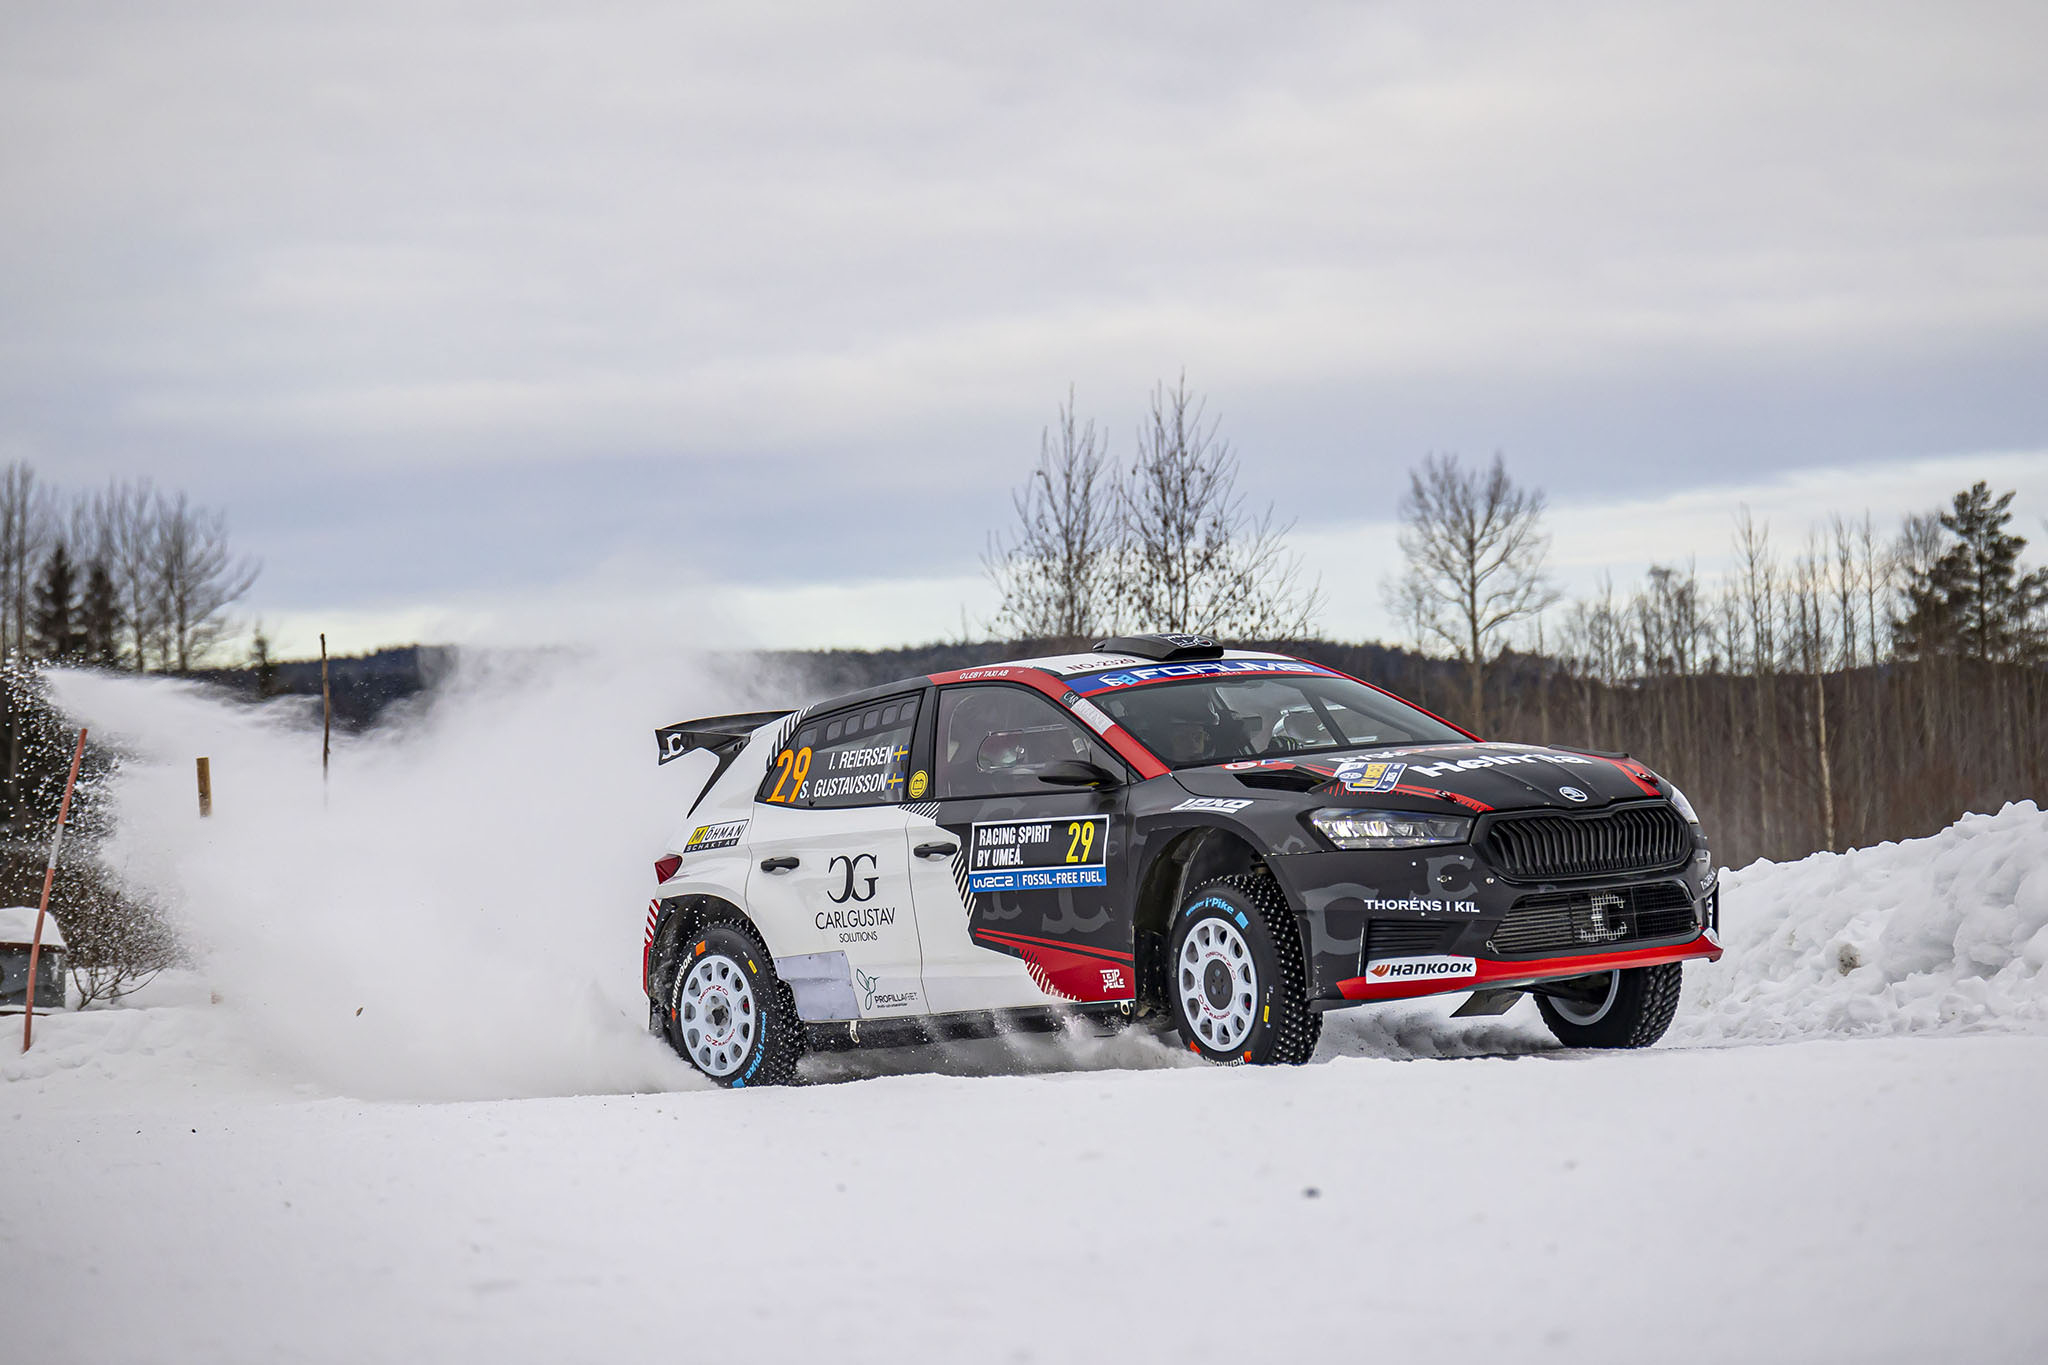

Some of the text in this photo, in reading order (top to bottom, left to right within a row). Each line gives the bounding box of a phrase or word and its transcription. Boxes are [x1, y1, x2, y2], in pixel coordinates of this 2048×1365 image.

[838, 745, 894, 769] REIERSEN
[1408, 753, 1593, 778] Helmia
[766, 747, 813, 803] 29
[800, 773, 889, 799] S. GUSTAVSSON
[686, 839, 737, 852] SCHAKT AB
[979, 824, 1052, 846] RACING SPIRIT
[1066, 821, 1095, 863] 29
[977, 844, 1024, 867] BY UMEÅ.
[973, 870, 1102, 889] WRC2 FOSSIL-FREE FUEL
[1363, 896, 1441, 911] THORÉNS
[1454, 901, 1480, 913] KIL
[839, 931, 878, 943] SOLUTIONS
